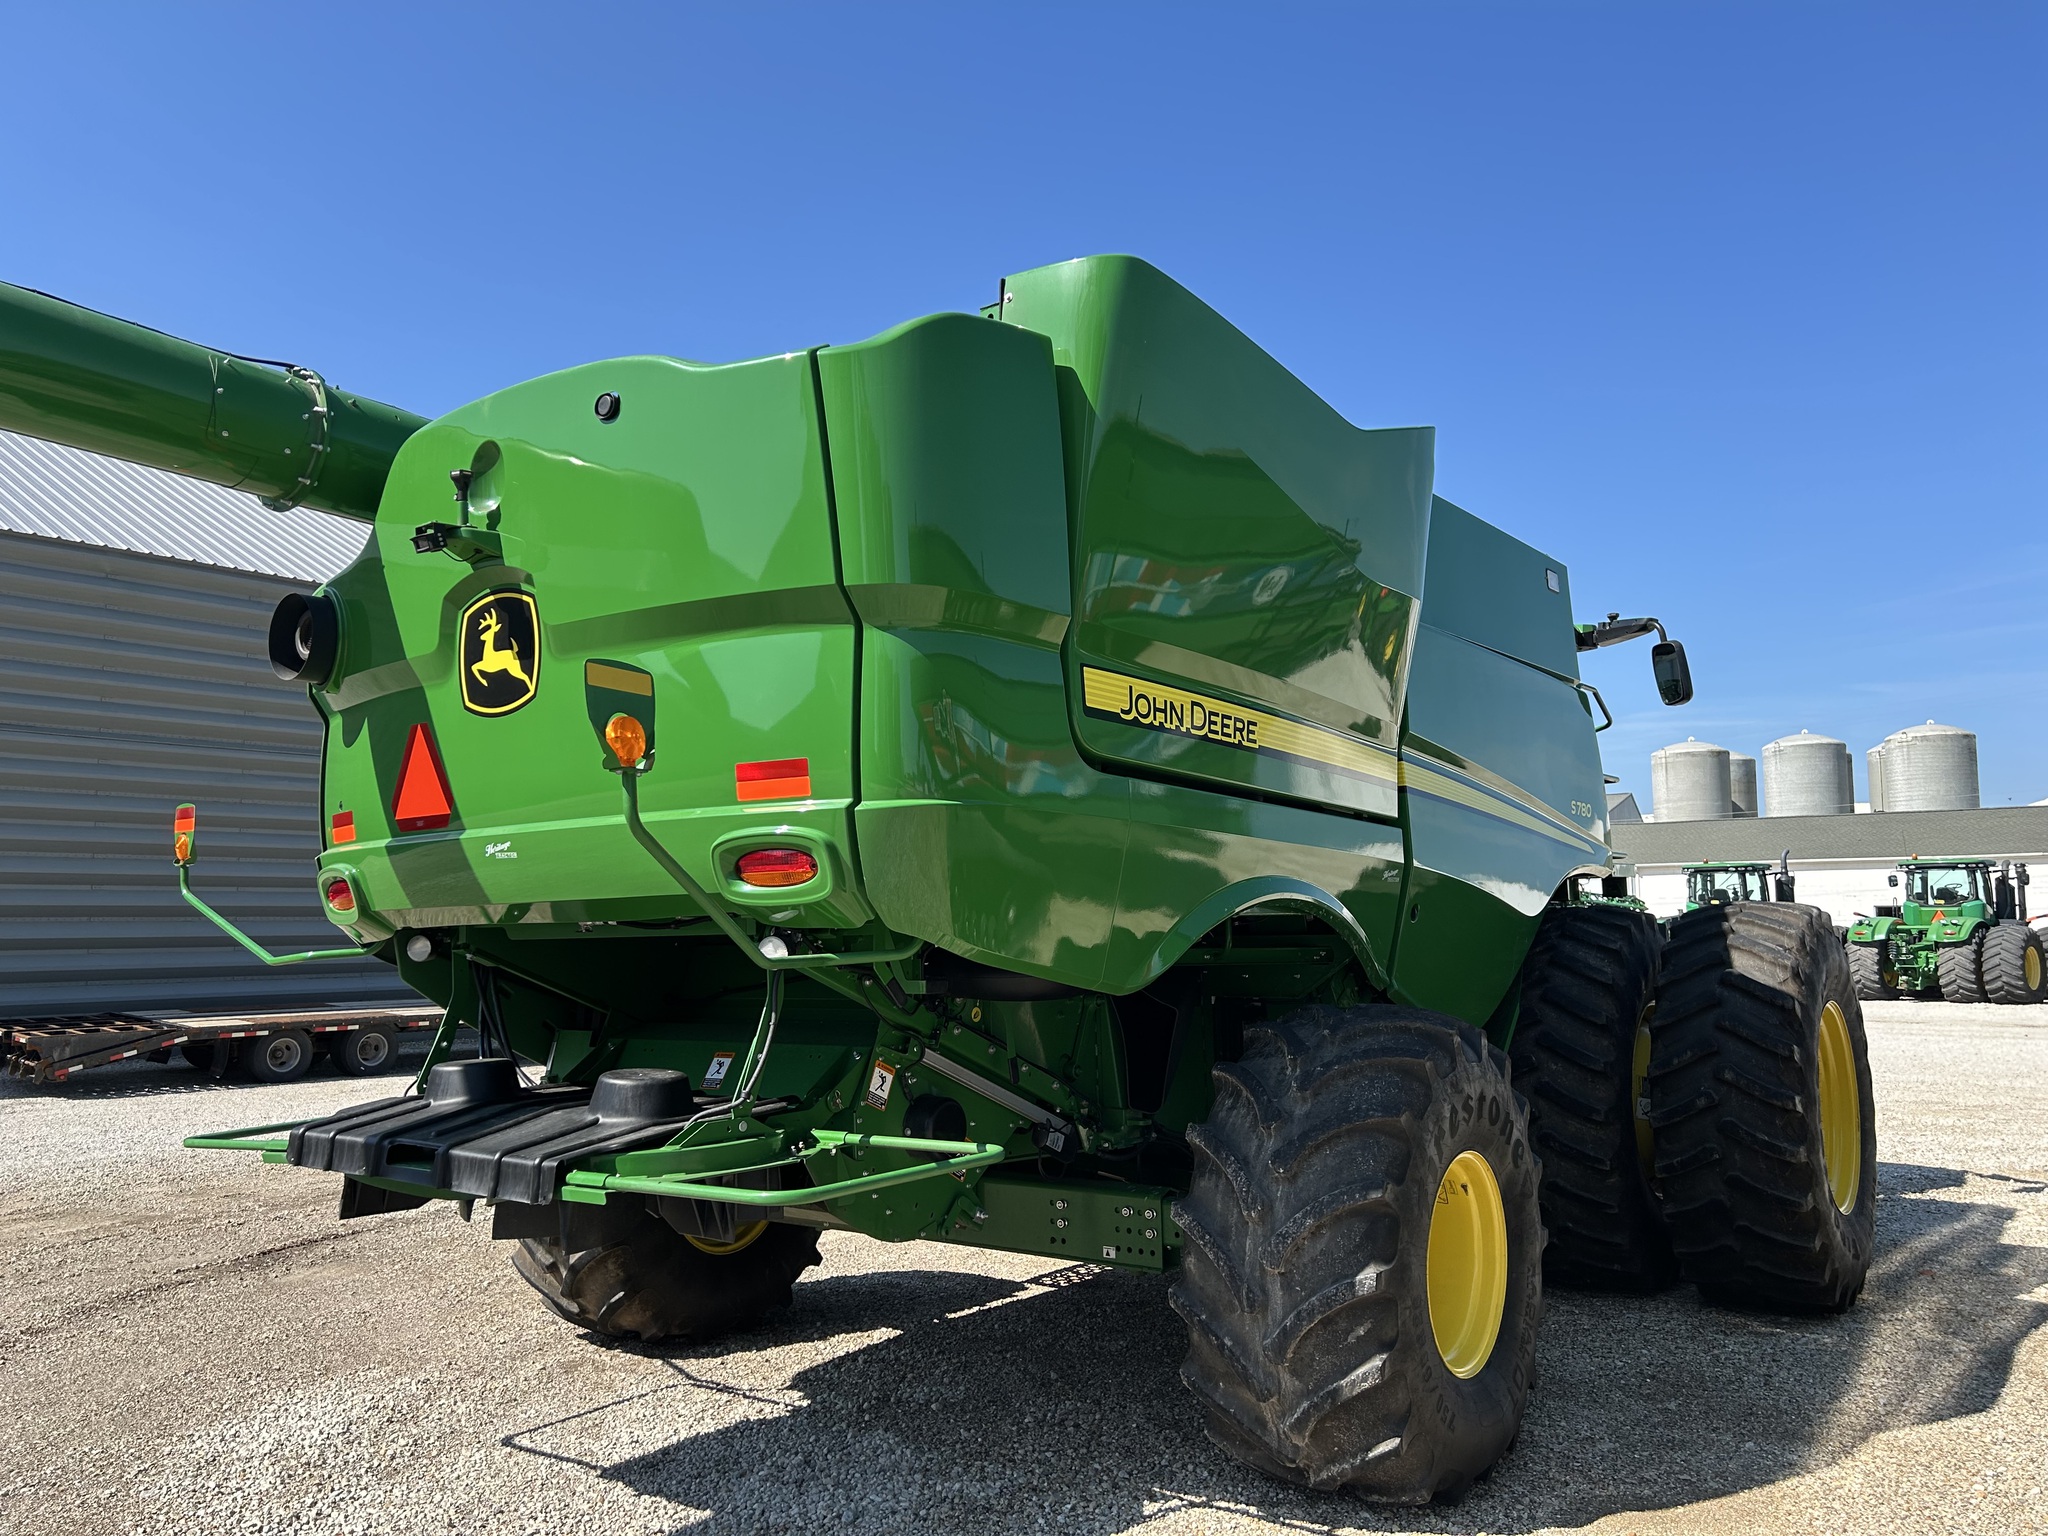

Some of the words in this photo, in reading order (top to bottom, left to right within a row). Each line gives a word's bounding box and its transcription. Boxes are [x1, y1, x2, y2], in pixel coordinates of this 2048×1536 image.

[1120, 685, 1186, 730] JOHN
[1190, 699, 1259, 746] DEERE
[1571, 800, 1592, 818] S780
